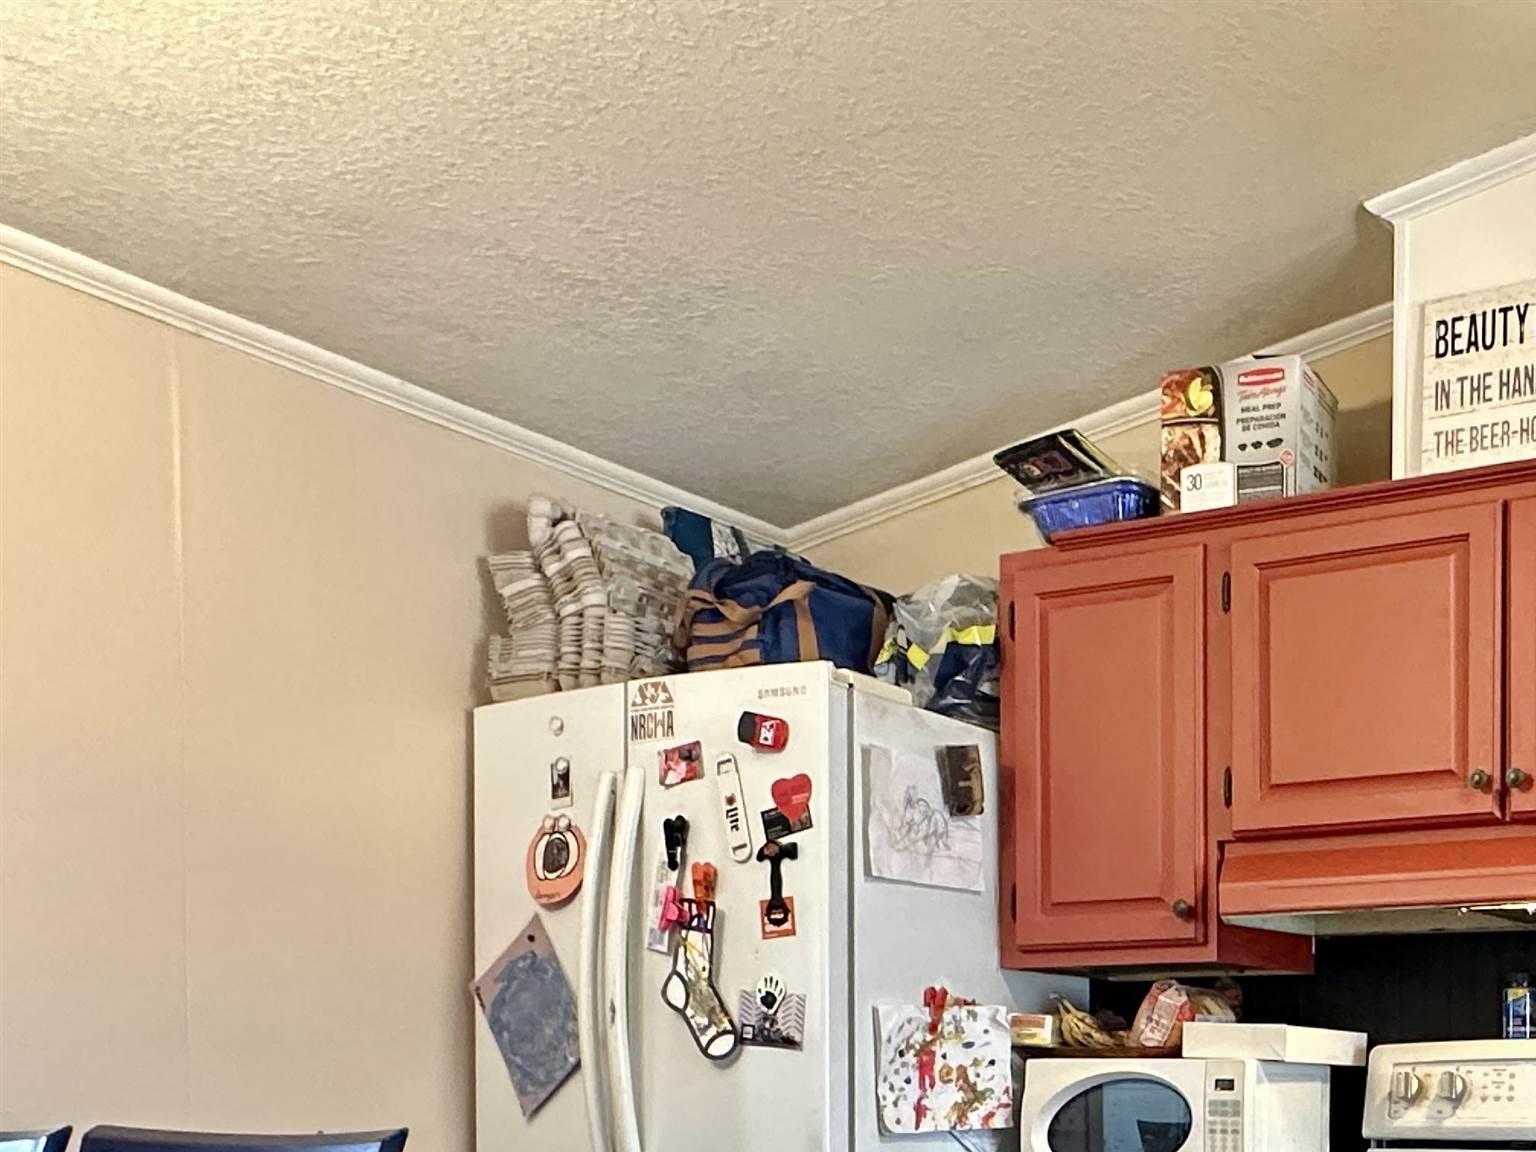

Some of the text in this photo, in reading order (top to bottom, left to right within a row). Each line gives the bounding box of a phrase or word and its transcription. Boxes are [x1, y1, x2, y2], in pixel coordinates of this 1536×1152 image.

[1434, 303, 1529, 359] BEAUTY
[1434, 379, 1451, 411] IN
[1457, 371, 1493, 408] THE
[1434, 428, 1465, 458] THE
[1186, 473, 1203, 491] 30
[758, 685, 807, 700] SAMSUNG
[726, 807, 740, 832] Lite
